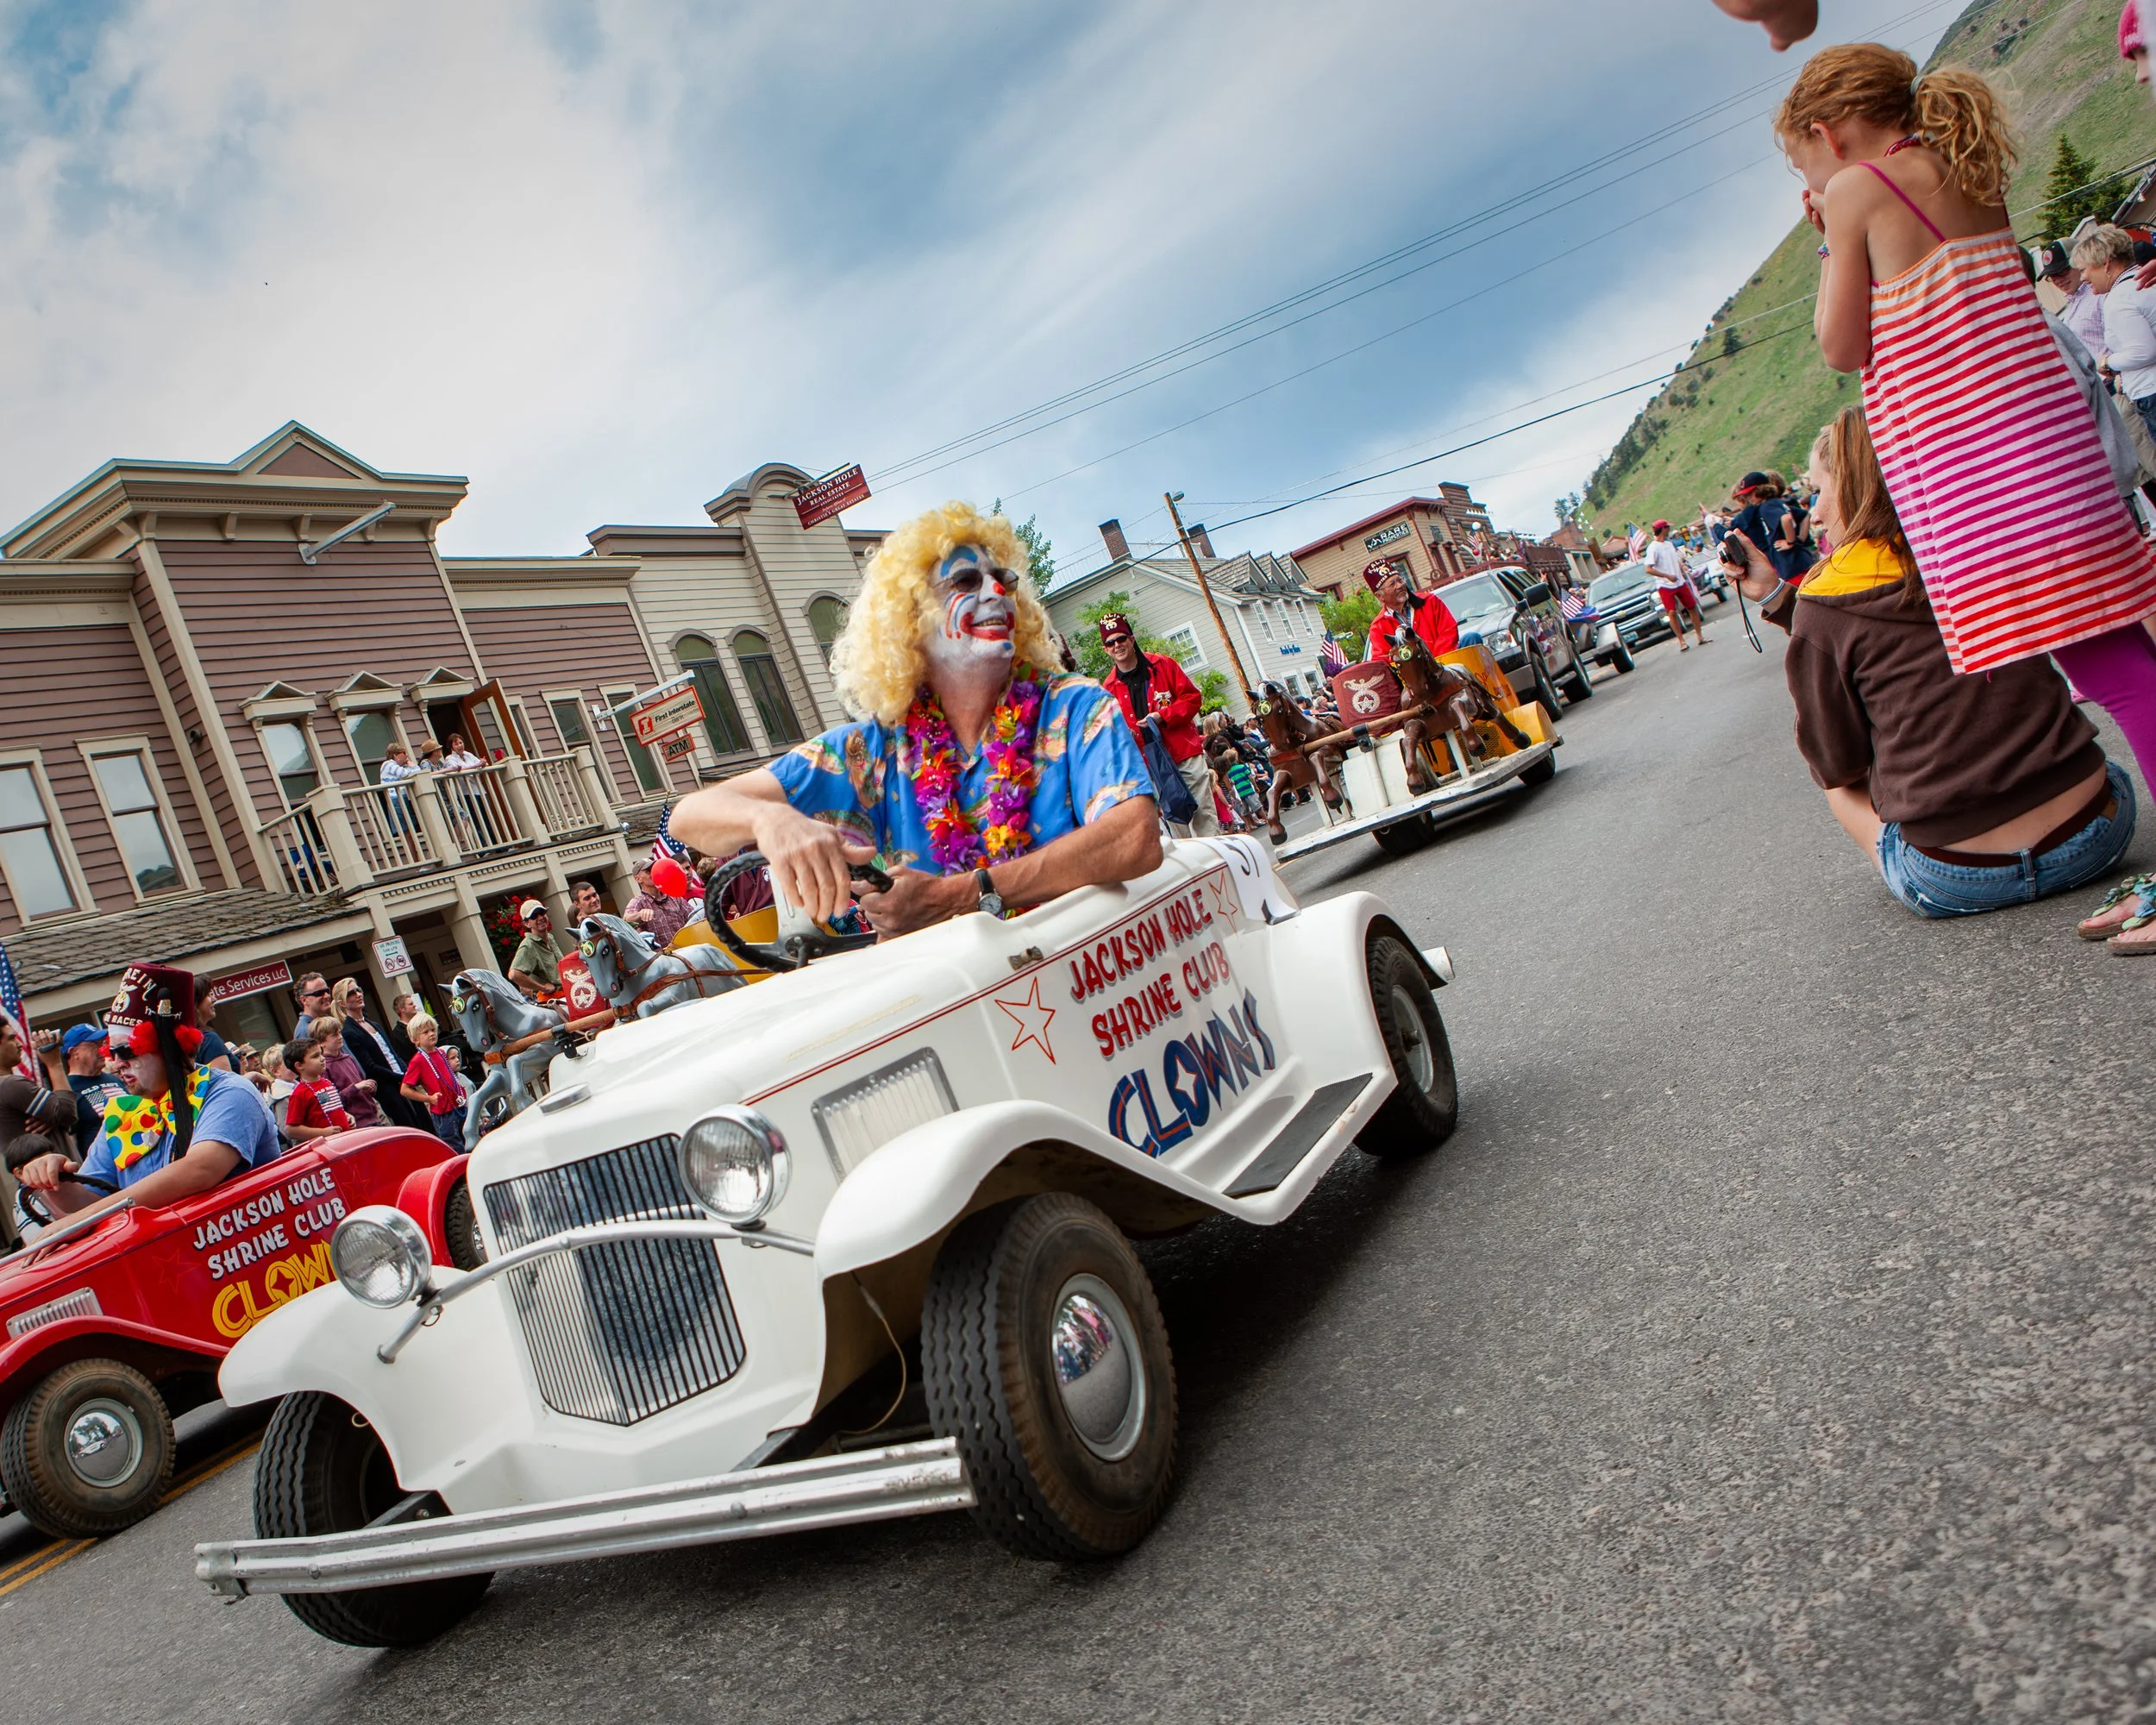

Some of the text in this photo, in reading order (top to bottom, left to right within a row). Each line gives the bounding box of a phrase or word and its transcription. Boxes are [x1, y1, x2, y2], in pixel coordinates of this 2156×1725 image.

[797, 467, 859, 505] JACKSON HOLE
[810, 481, 851, 506] REAL ESTATE
[847, 493, 866, 506] ESTATES
[1380, 523, 1407, 541] RARE
[655, 699, 696, 723] First Interstate
[672, 714, 685, 724] Bank
[667, 739, 689, 756] ATM
[1070, 888, 1213, 1001] JACKSON HOLE
[226, 972, 271, 993] Services
[271, 968, 286, 981] LLC
[1091, 941, 1231, 1058] SHRINE CLUB
[1107, 986, 1275, 1159] CLOWNS
[193, 1167, 336, 1250] JACKSON HOLE
[207, 1196, 346, 1279] SHRINE CLUB
